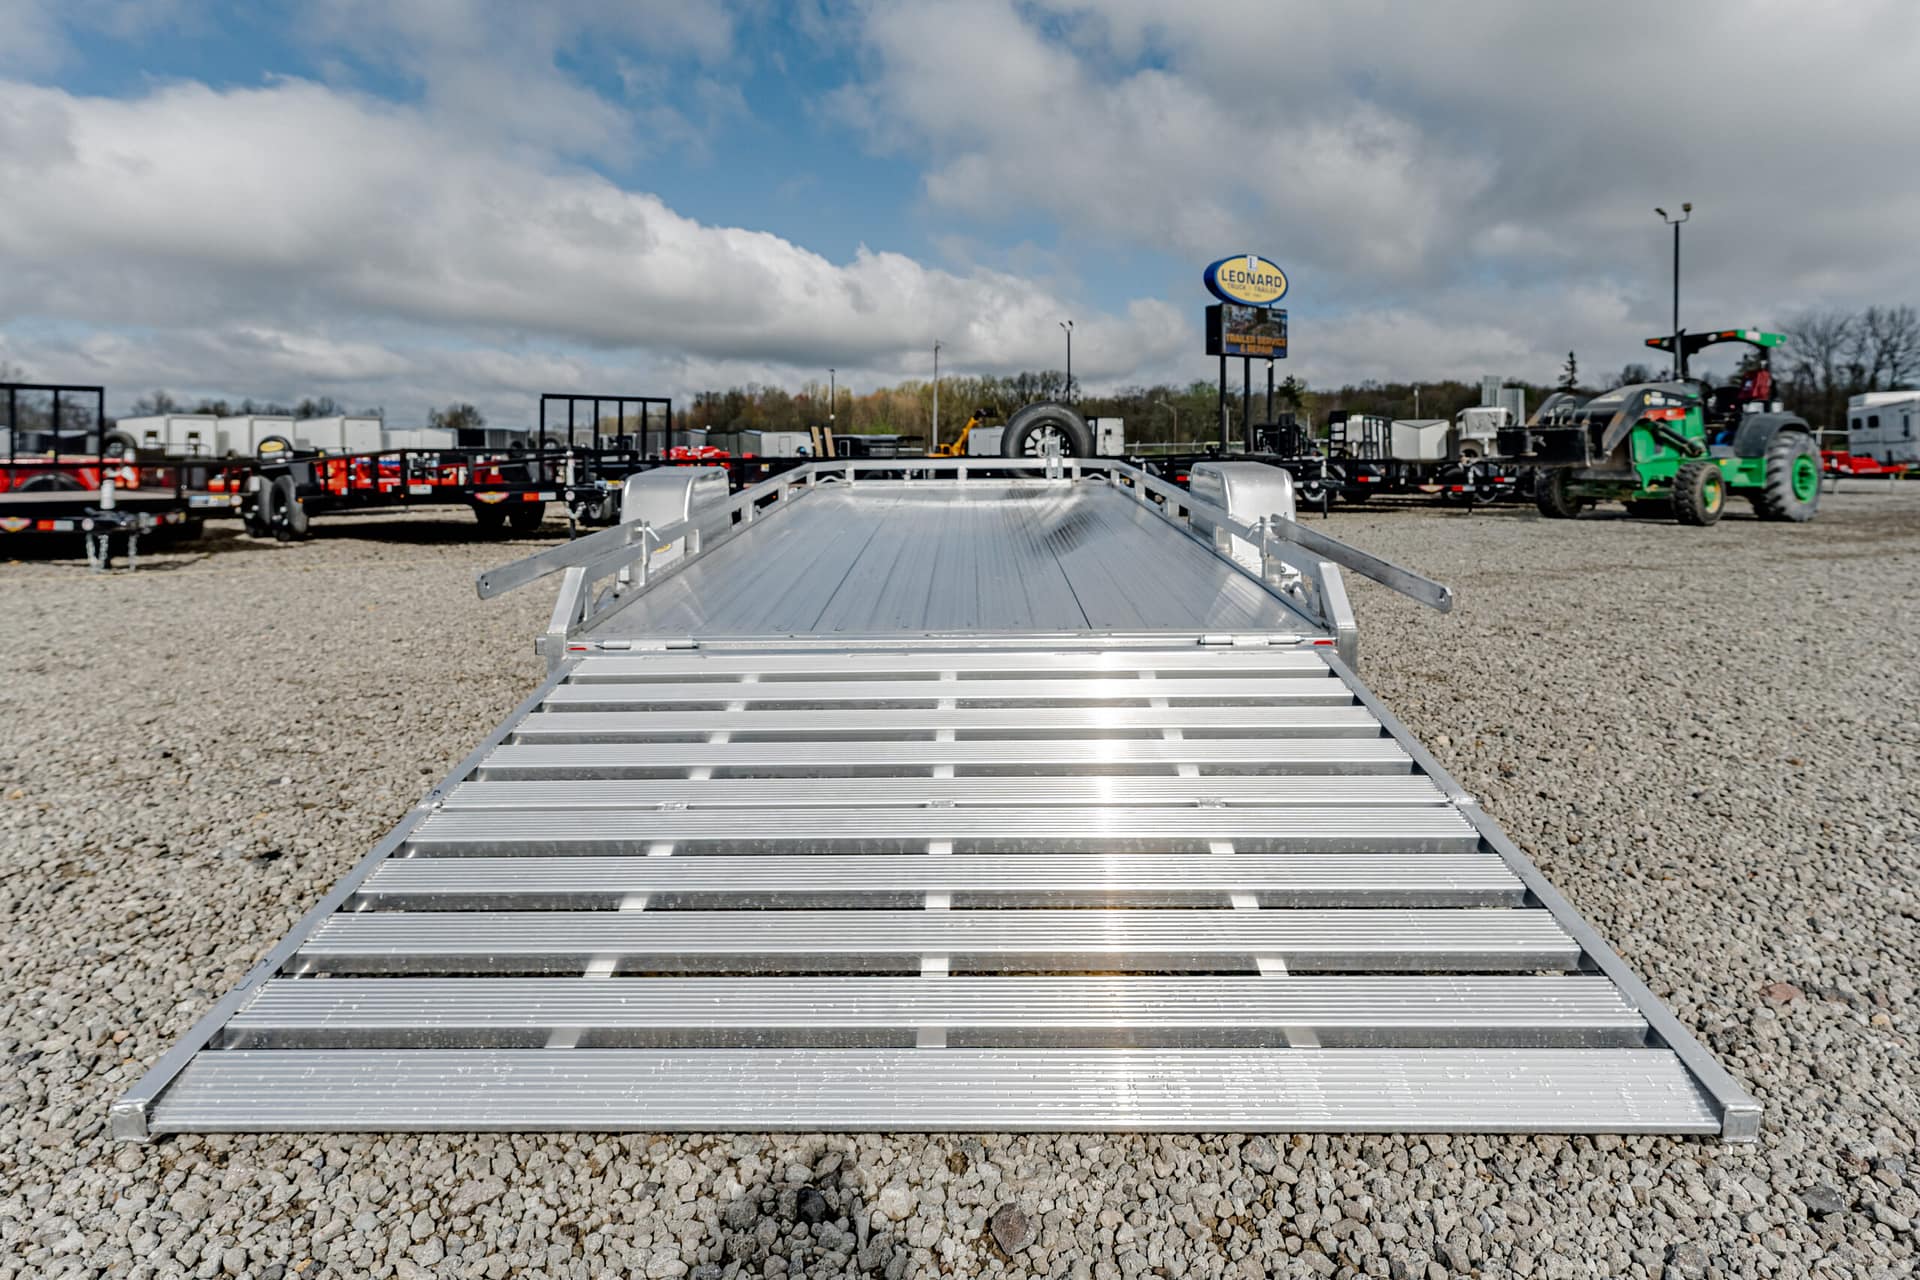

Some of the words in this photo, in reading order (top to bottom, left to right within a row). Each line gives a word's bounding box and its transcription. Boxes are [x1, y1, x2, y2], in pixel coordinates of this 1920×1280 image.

[1221, 269, 1282, 288] LEONARD
[1227, 283, 1246, 291] TRUCK
[1254, 286, 1277, 294] TRAILER
